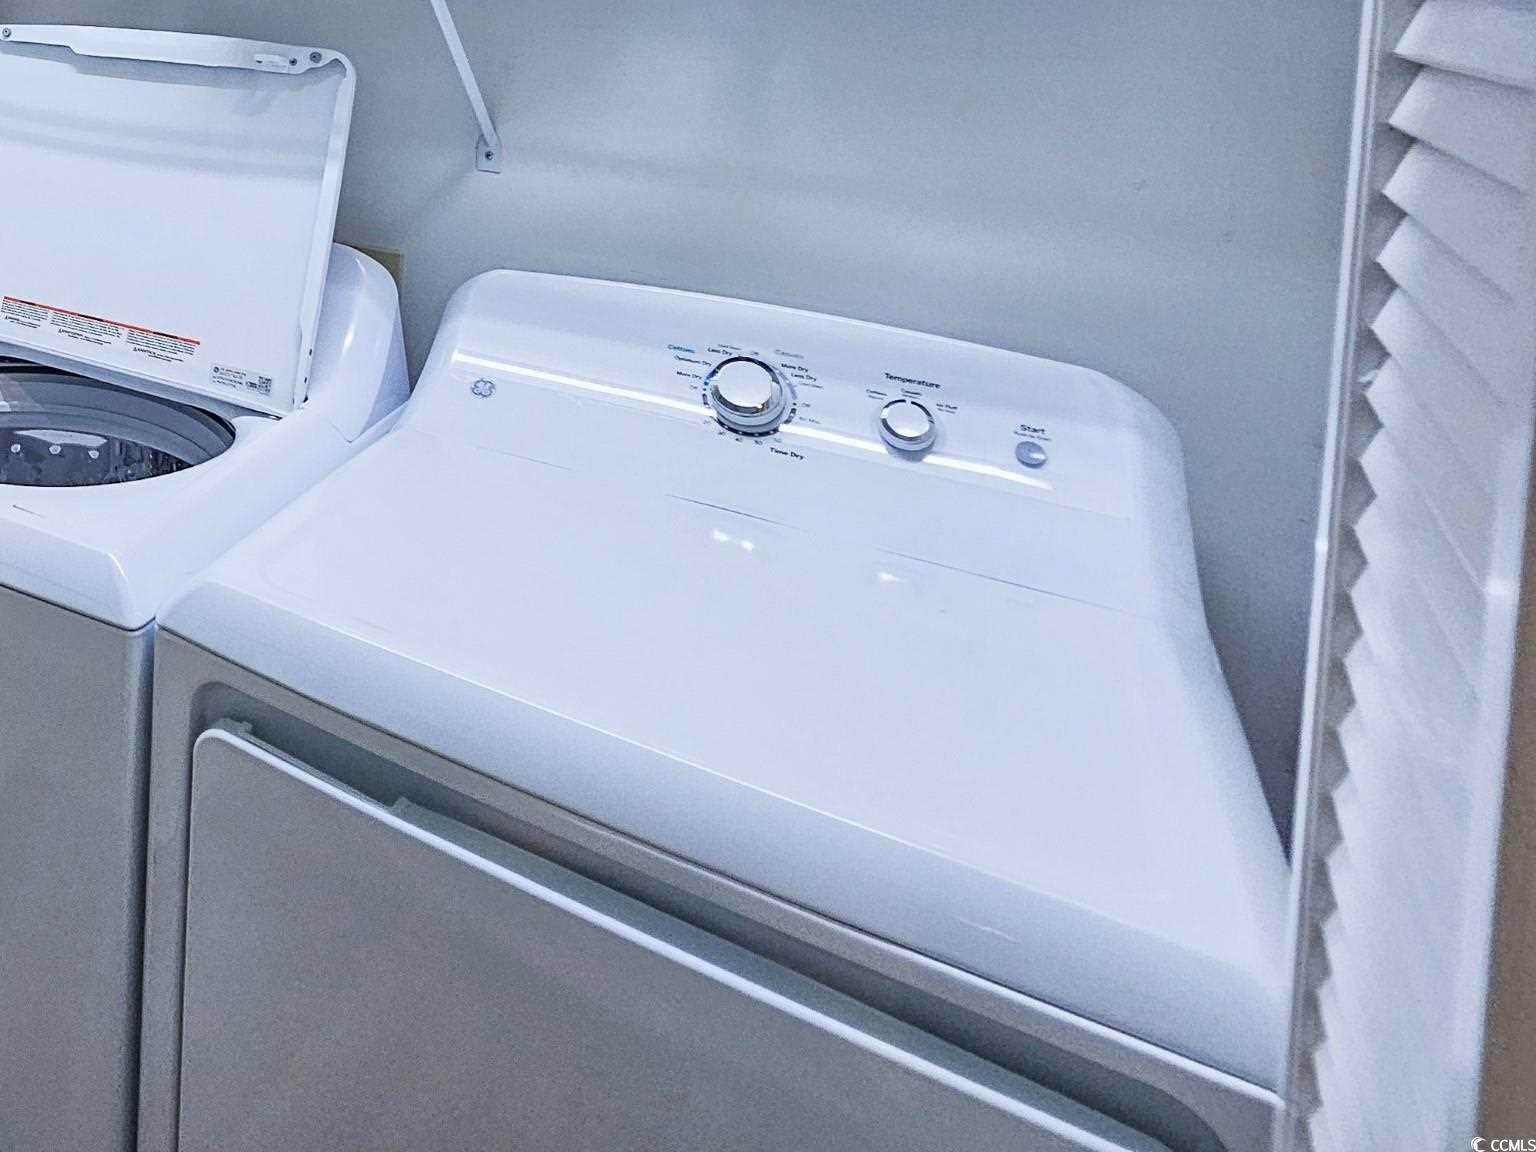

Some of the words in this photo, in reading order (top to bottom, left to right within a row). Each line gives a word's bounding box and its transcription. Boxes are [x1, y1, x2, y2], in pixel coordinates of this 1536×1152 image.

[884, 372, 941, 389] Temperature
[1020, 424, 1046, 435] Start
[770, 446, 789, 457] Time
[790, 451, 804, 461] Dry
